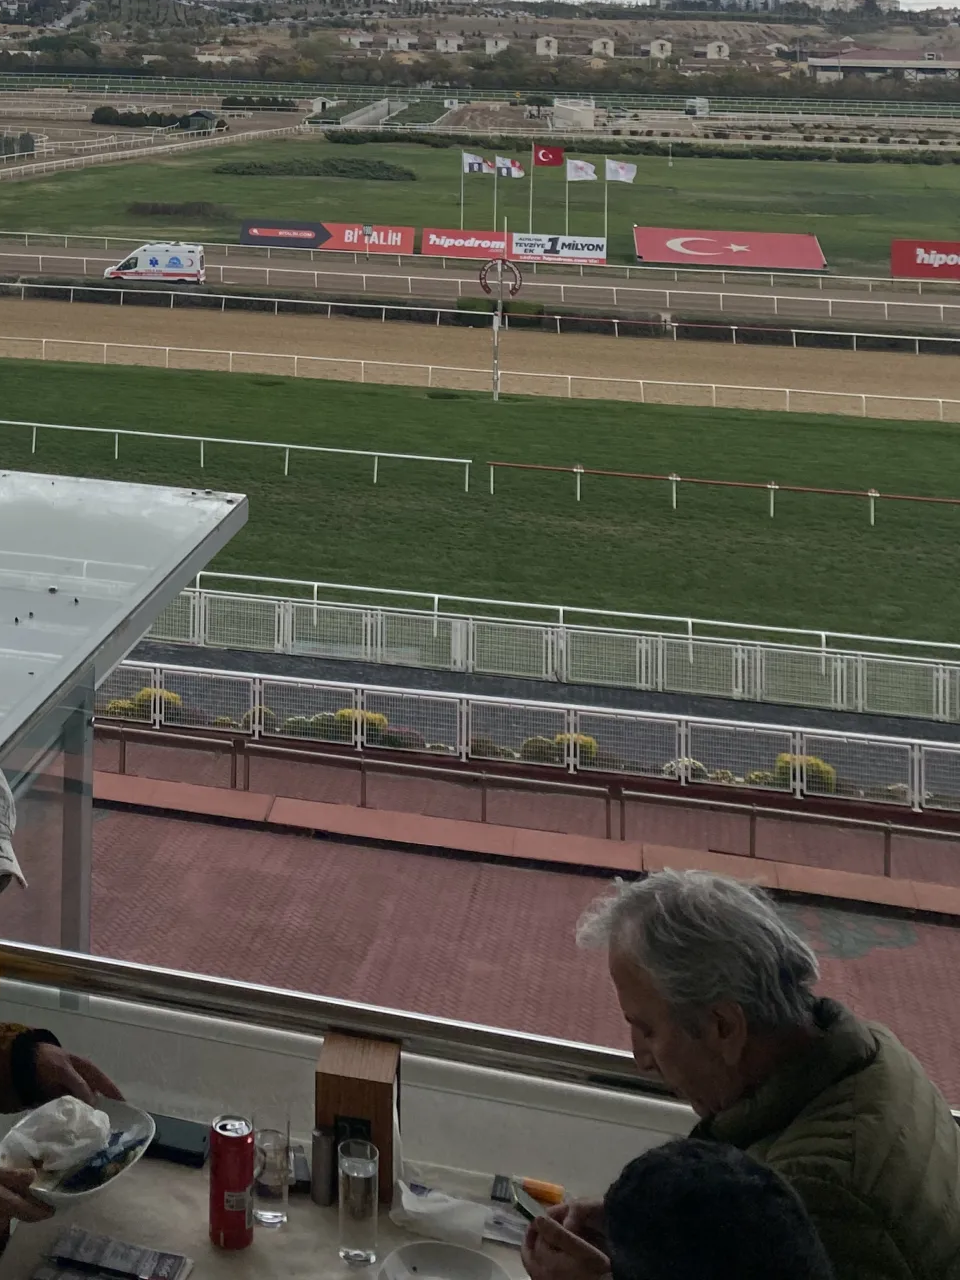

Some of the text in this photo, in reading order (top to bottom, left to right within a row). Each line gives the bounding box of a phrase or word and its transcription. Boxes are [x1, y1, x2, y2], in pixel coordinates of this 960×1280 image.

[428, 234, 506, 249] hipodrom
[515, 241, 546, 249] TEVZİYE
[543, 236, 605, 255] 1 MİLYON
[916, 248, 960, 268] hipo
